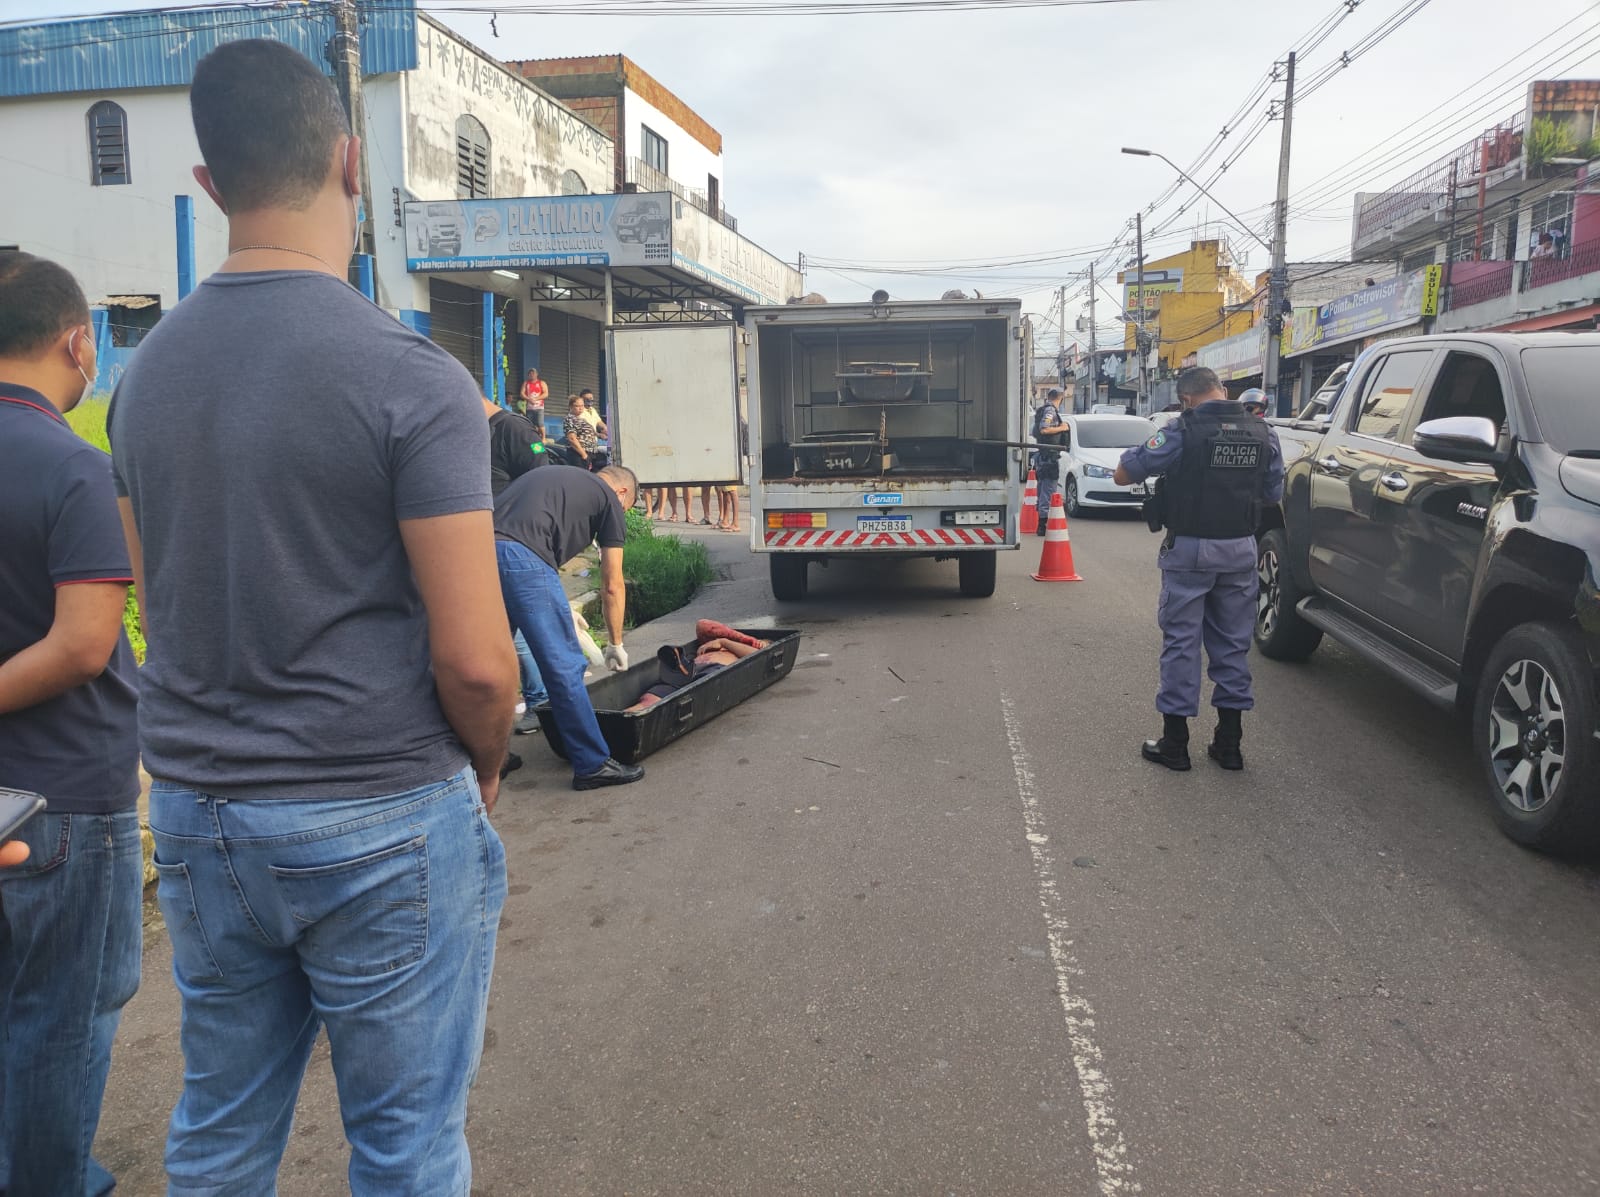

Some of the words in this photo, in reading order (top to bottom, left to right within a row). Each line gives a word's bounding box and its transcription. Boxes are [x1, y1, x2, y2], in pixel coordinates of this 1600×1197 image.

[508, 202, 605, 236] PLATINADO
[508, 239, 543, 252] CENTRO
[544, 236, 605, 251] AUTOMOTIVO
[1424, 266, 1437, 314] INSULFILM
[1328, 298, 1348, 317] Point
[1352, 282, 1399, 308] Retrovisor
[1214, 444, 1257, 456] POLÍCIA
[1213, 455, 1257, 465] MILITAR
[862, 521, 906, 532] PHZ5B38
